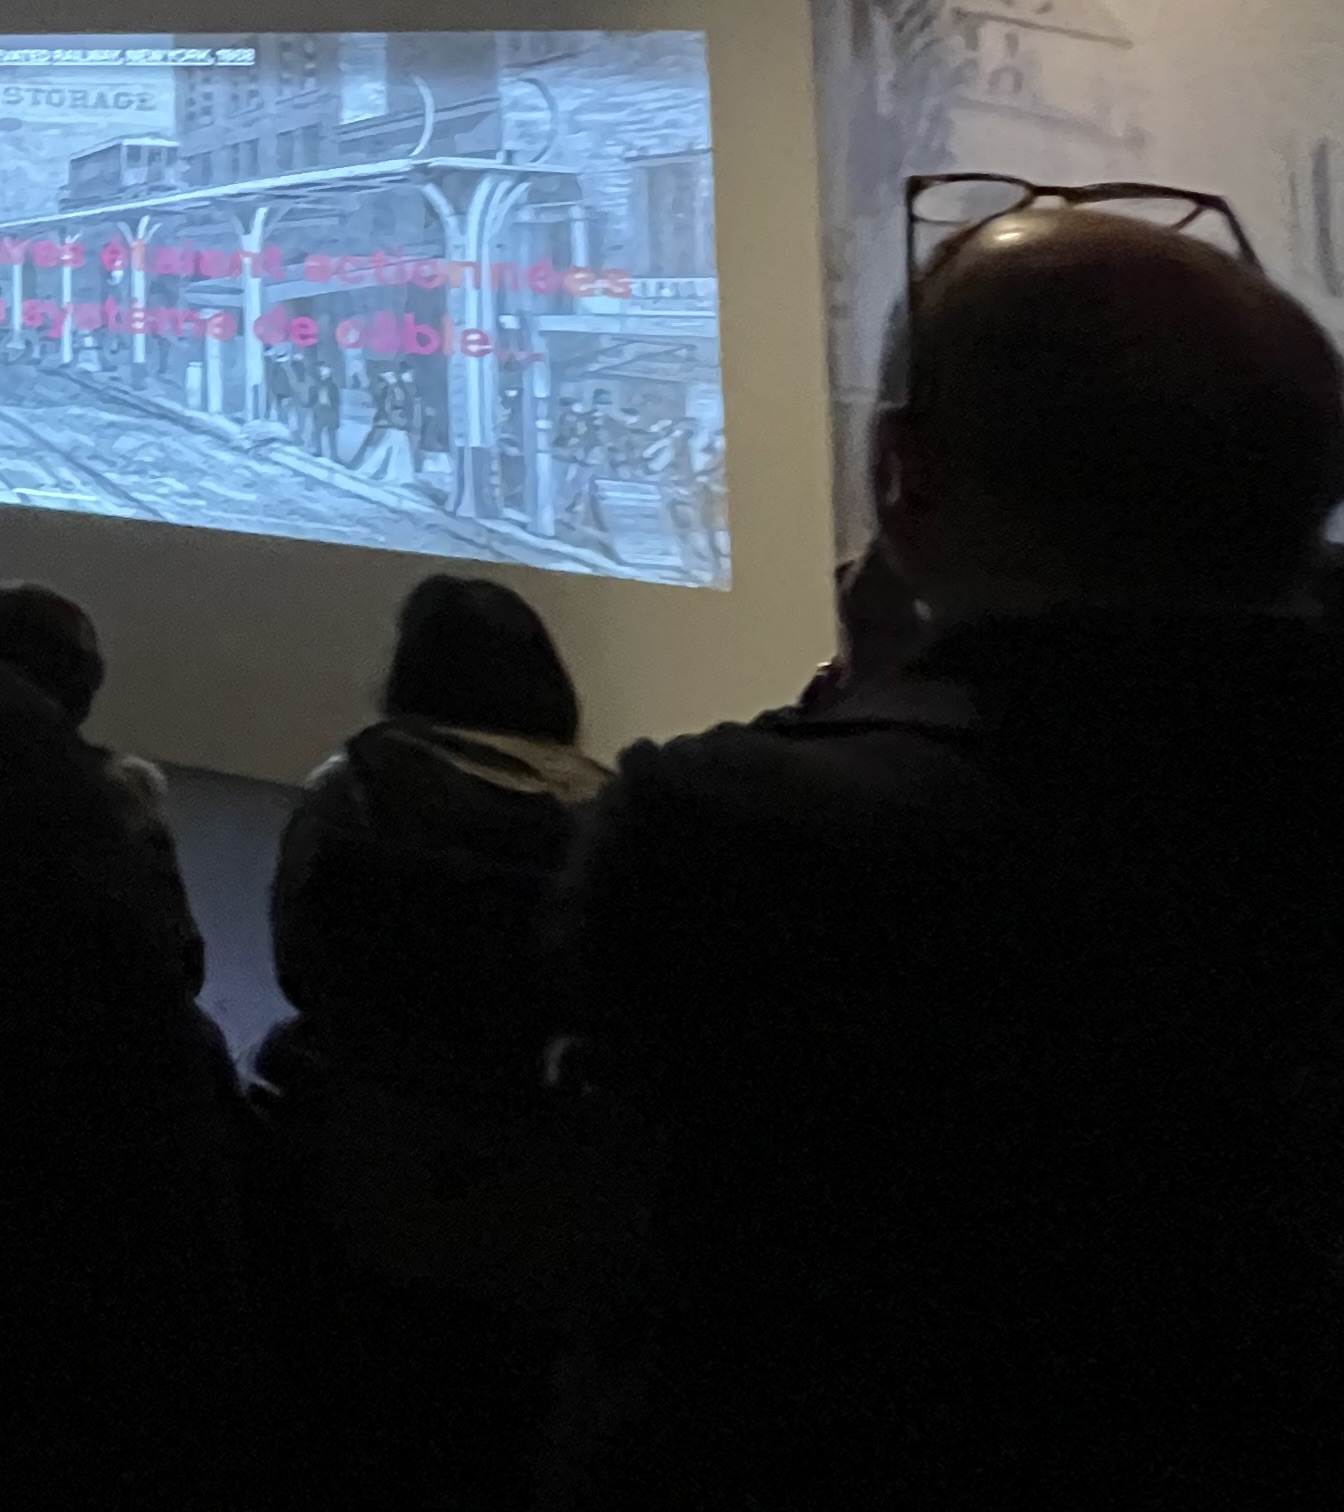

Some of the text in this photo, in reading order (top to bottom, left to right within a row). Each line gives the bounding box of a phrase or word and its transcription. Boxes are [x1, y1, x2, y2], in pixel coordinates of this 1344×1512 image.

[2, 86, 157, 112] STORAGE
[100, 235, 283, 282] étaient
[304, 246, 631, 299] actionnées
[22, 294, 238, 342] système
[253, 302, 319, 347] de
